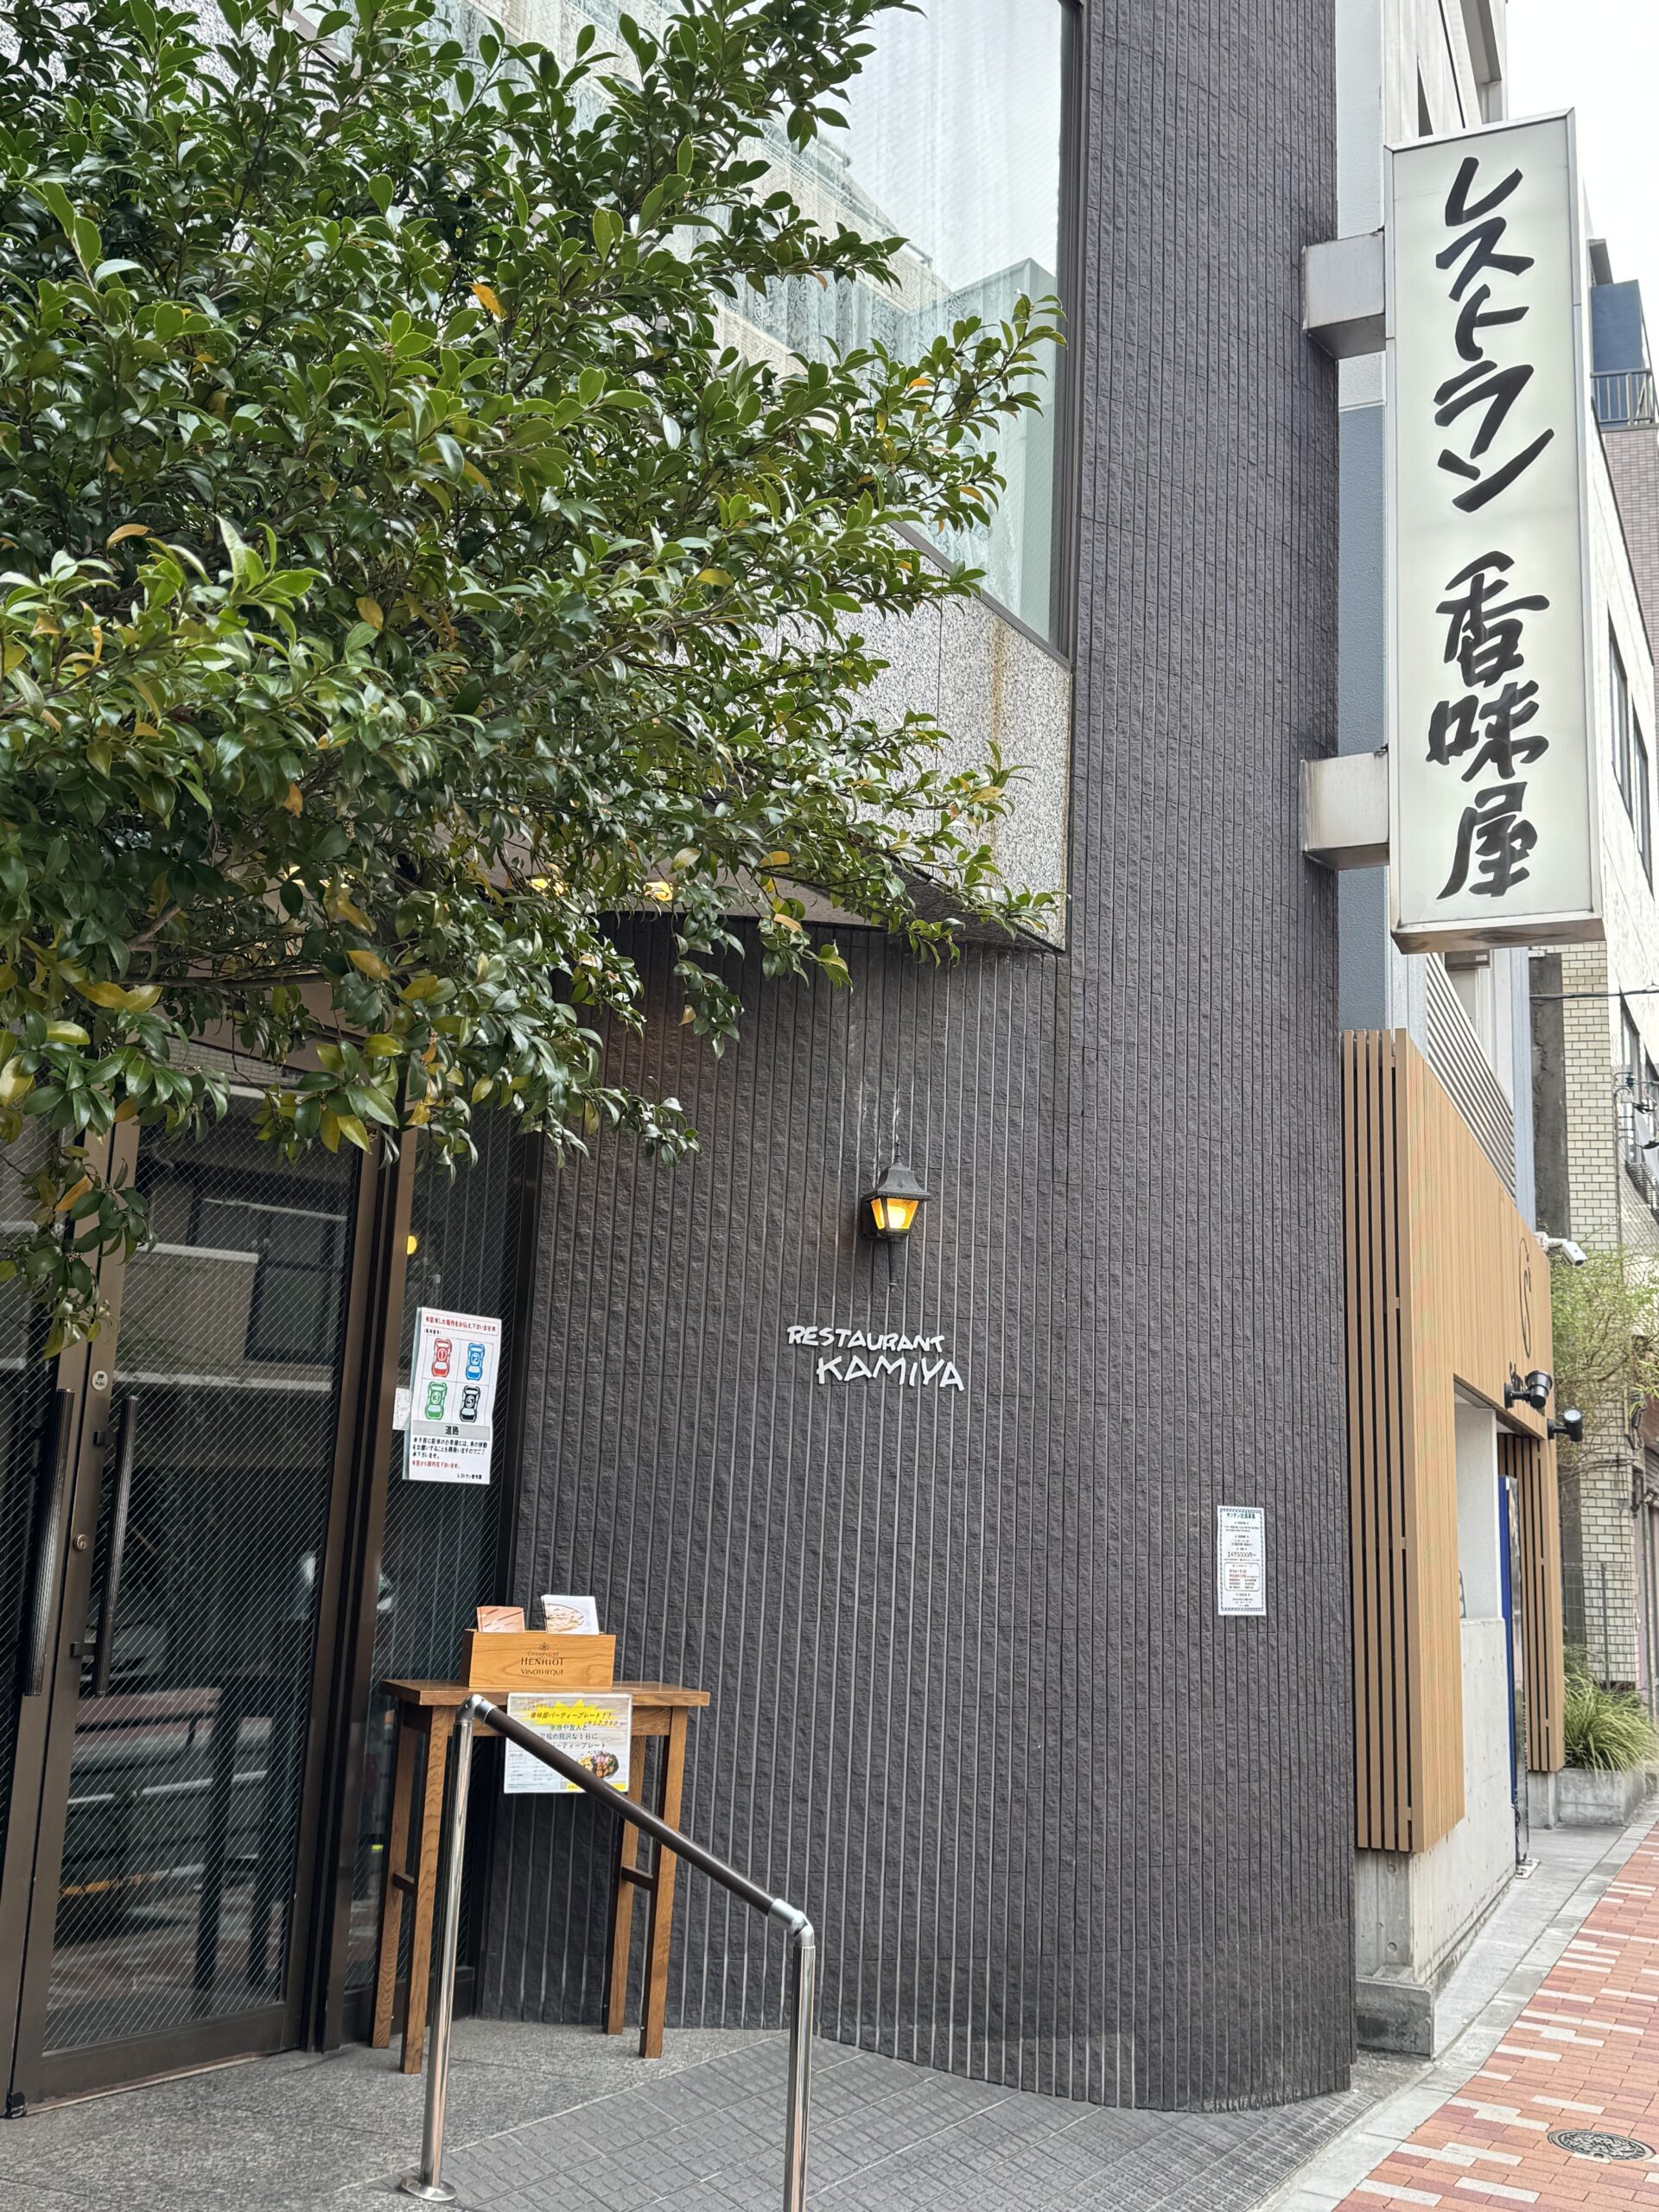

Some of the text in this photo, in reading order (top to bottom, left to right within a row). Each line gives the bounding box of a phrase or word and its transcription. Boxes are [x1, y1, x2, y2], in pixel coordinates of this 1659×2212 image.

[1427, 156, 1554, 899] レストラン 香味屋
[787, 1325, 945, 1353] RESTAURANT
[817, 1355, 965, 1392] KAMIYA
[521, 1656, 563, 1666] HENRIOT
